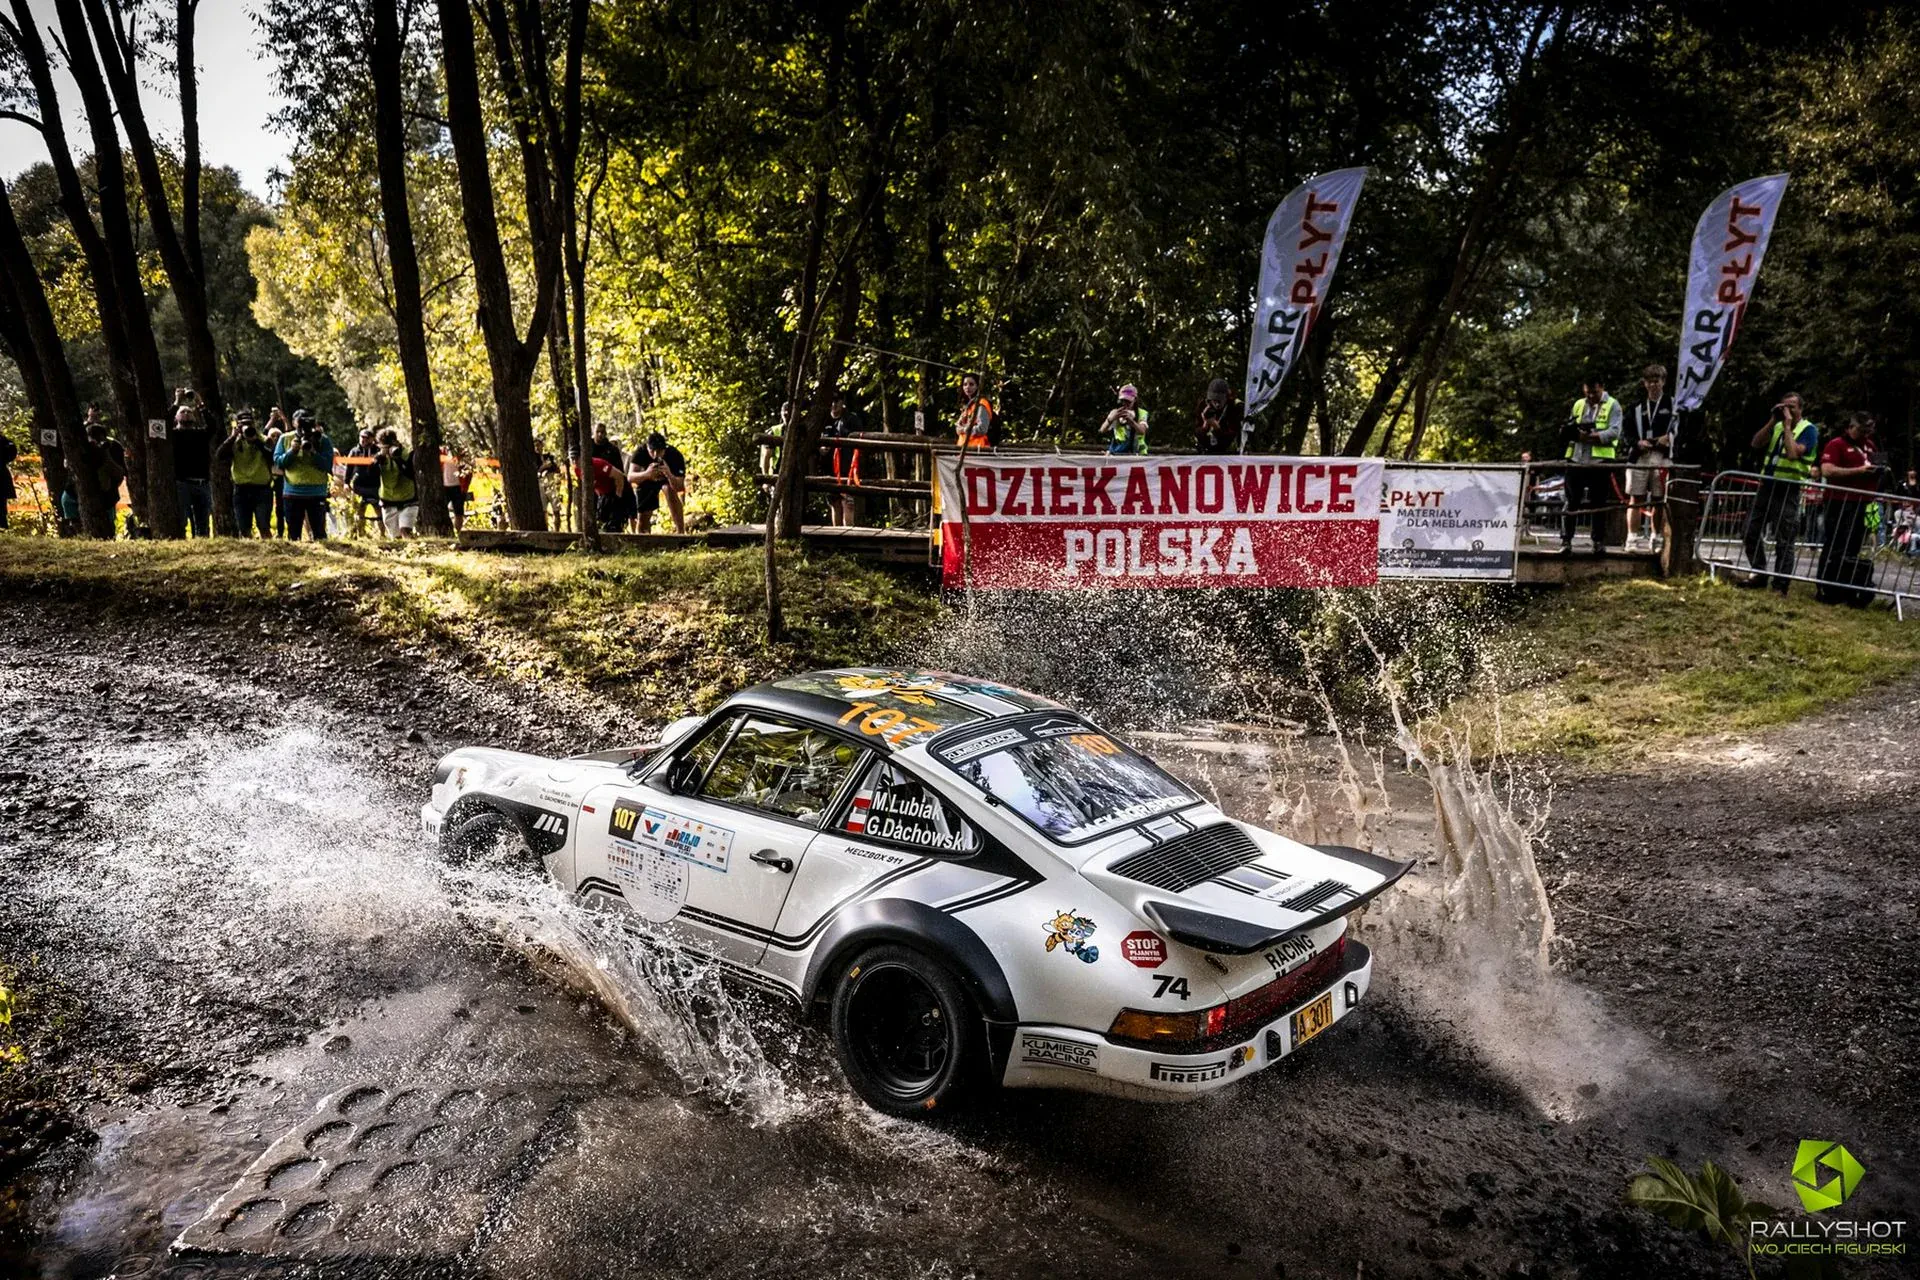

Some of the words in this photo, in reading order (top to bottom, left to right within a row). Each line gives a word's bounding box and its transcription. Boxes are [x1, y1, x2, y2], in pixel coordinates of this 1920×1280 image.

[1252, 310, 1301, 393] ŻAR
[1291, 192, 1338, 304] PŁYT
[1679, 309, 1725, 389] ŻAR
[1718, 197, 1761, 303] PŁYT
[964, 464, 1358, 516] DZIEKANOWICE
[1391, 490, 1444, 507] PŁYT
[1397, 508, 1461, 518] MATERIAŁY
[1406, 519, 1429, 528] DLA
[1431, 519, 1508, 529] MEBLARSTWA
[1063, 527, 1259, 578] POLSKA
[837, 701, 944, 745] 107
[872, 792, 944, 821] M.Lubiak
[614, 807, 636, 830] 107
[844, 846, 887, 862] MECZBOX
[887, 855, 904, 865] 911
[1127, 938, 1160, 950] STOP
[1264, 934, 1315, 970] RACING
[1152, 974, 1191, 1001] 74
[1022, 1039, 1097, 1059] KUMIEGA
[1028, 1049, 1091, 1066] RACING
[1151, 1061, 1226, 1083] PIRELLI
